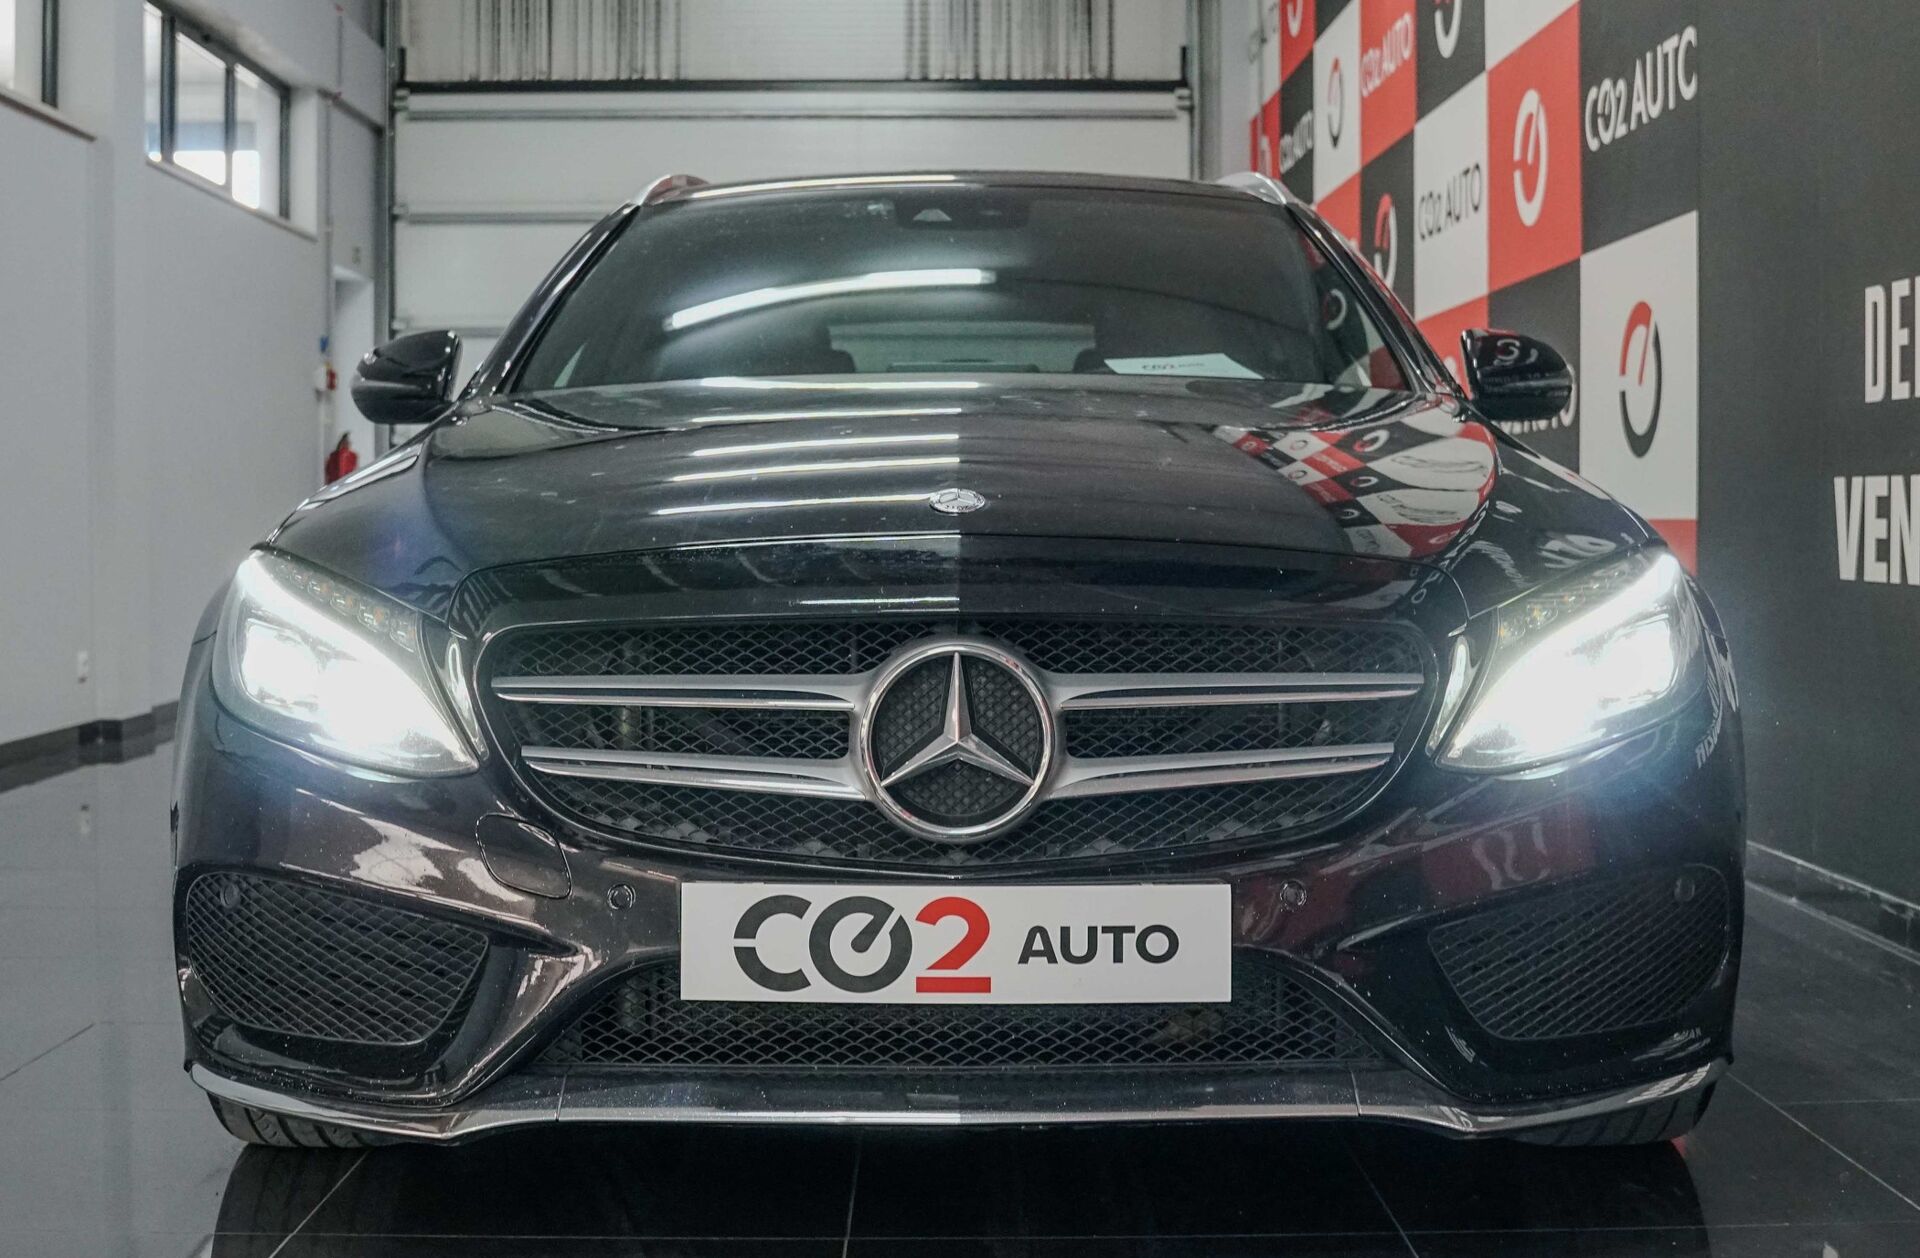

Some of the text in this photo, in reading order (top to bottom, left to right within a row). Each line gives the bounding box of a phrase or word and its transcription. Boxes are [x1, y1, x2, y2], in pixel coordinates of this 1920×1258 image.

[1585, 77, 1629, 152] CO2
[1444, 163, 1482, 231] AUTO
[733, 894, 1180, 994] CO2 AUTO
